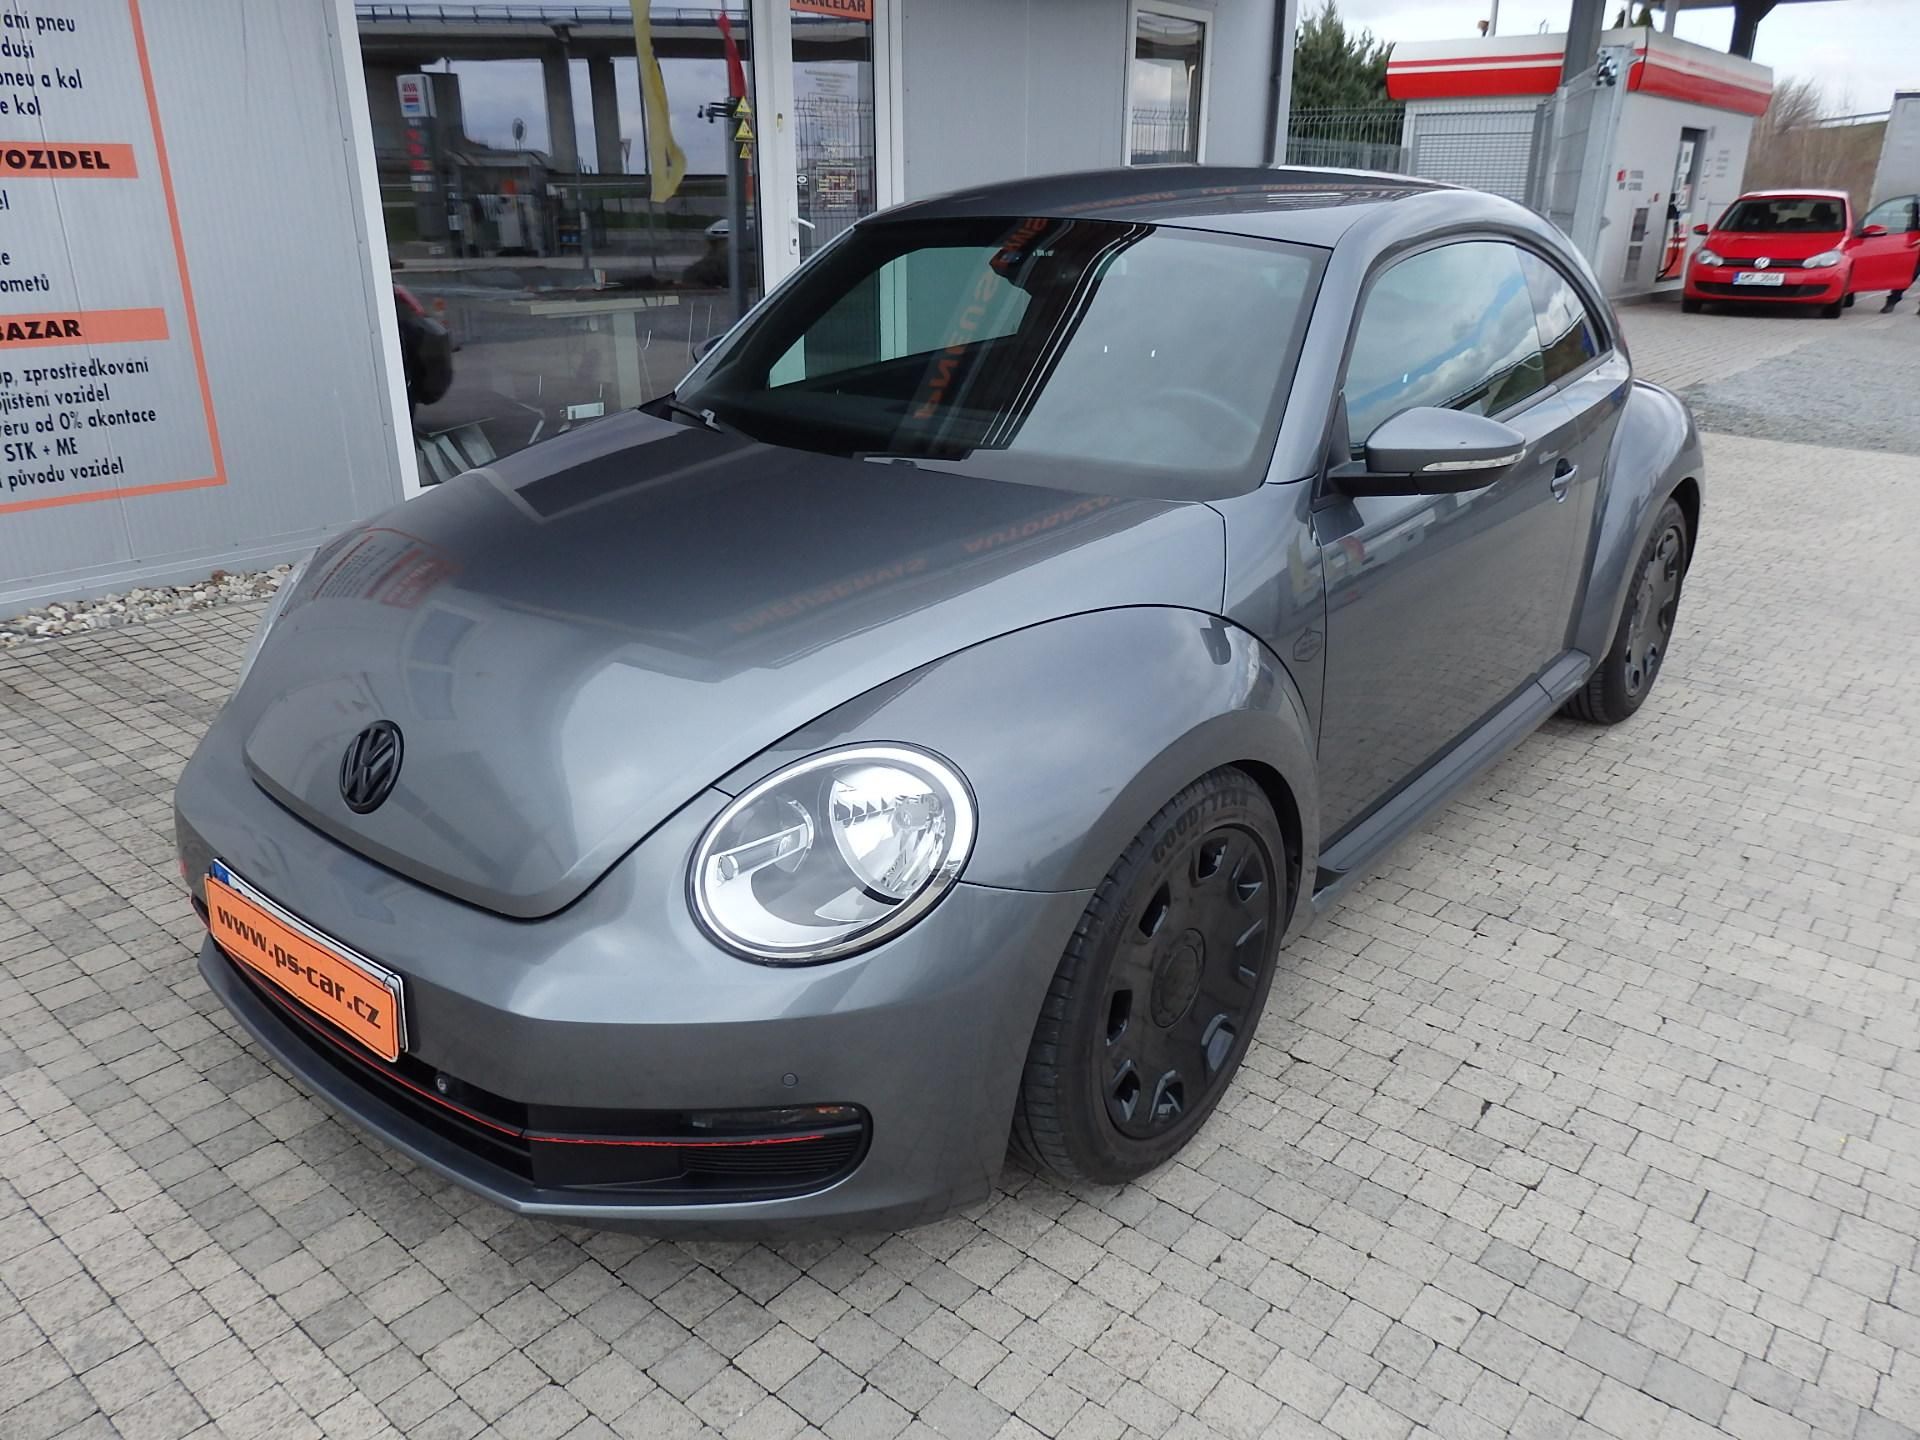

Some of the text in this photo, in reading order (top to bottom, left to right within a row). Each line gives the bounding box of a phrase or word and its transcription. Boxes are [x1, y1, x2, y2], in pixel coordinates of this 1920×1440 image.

[36, 17, 76, 36] pneu
[41, 75, 51, 87] a
[56, 68, 82, 89] kol
[14, 94, 41, 116] kol
[0, 150, 110, 170] OZIDEL
[24, 357, 149, 386] zprostředkování
[0, 383, 110, 415] jištění vozidel
[36, 413, 54, 433] od
[60, 410, 83, 431] 0%
[89, 408, 156, 428] akontace
[4, 441, 37, 462] STK
[56, 437, 78, 457] ME
[8, 456, 124, 492] původu vozidel
[217, 905, 381, 1029] www.ps-car.cz
